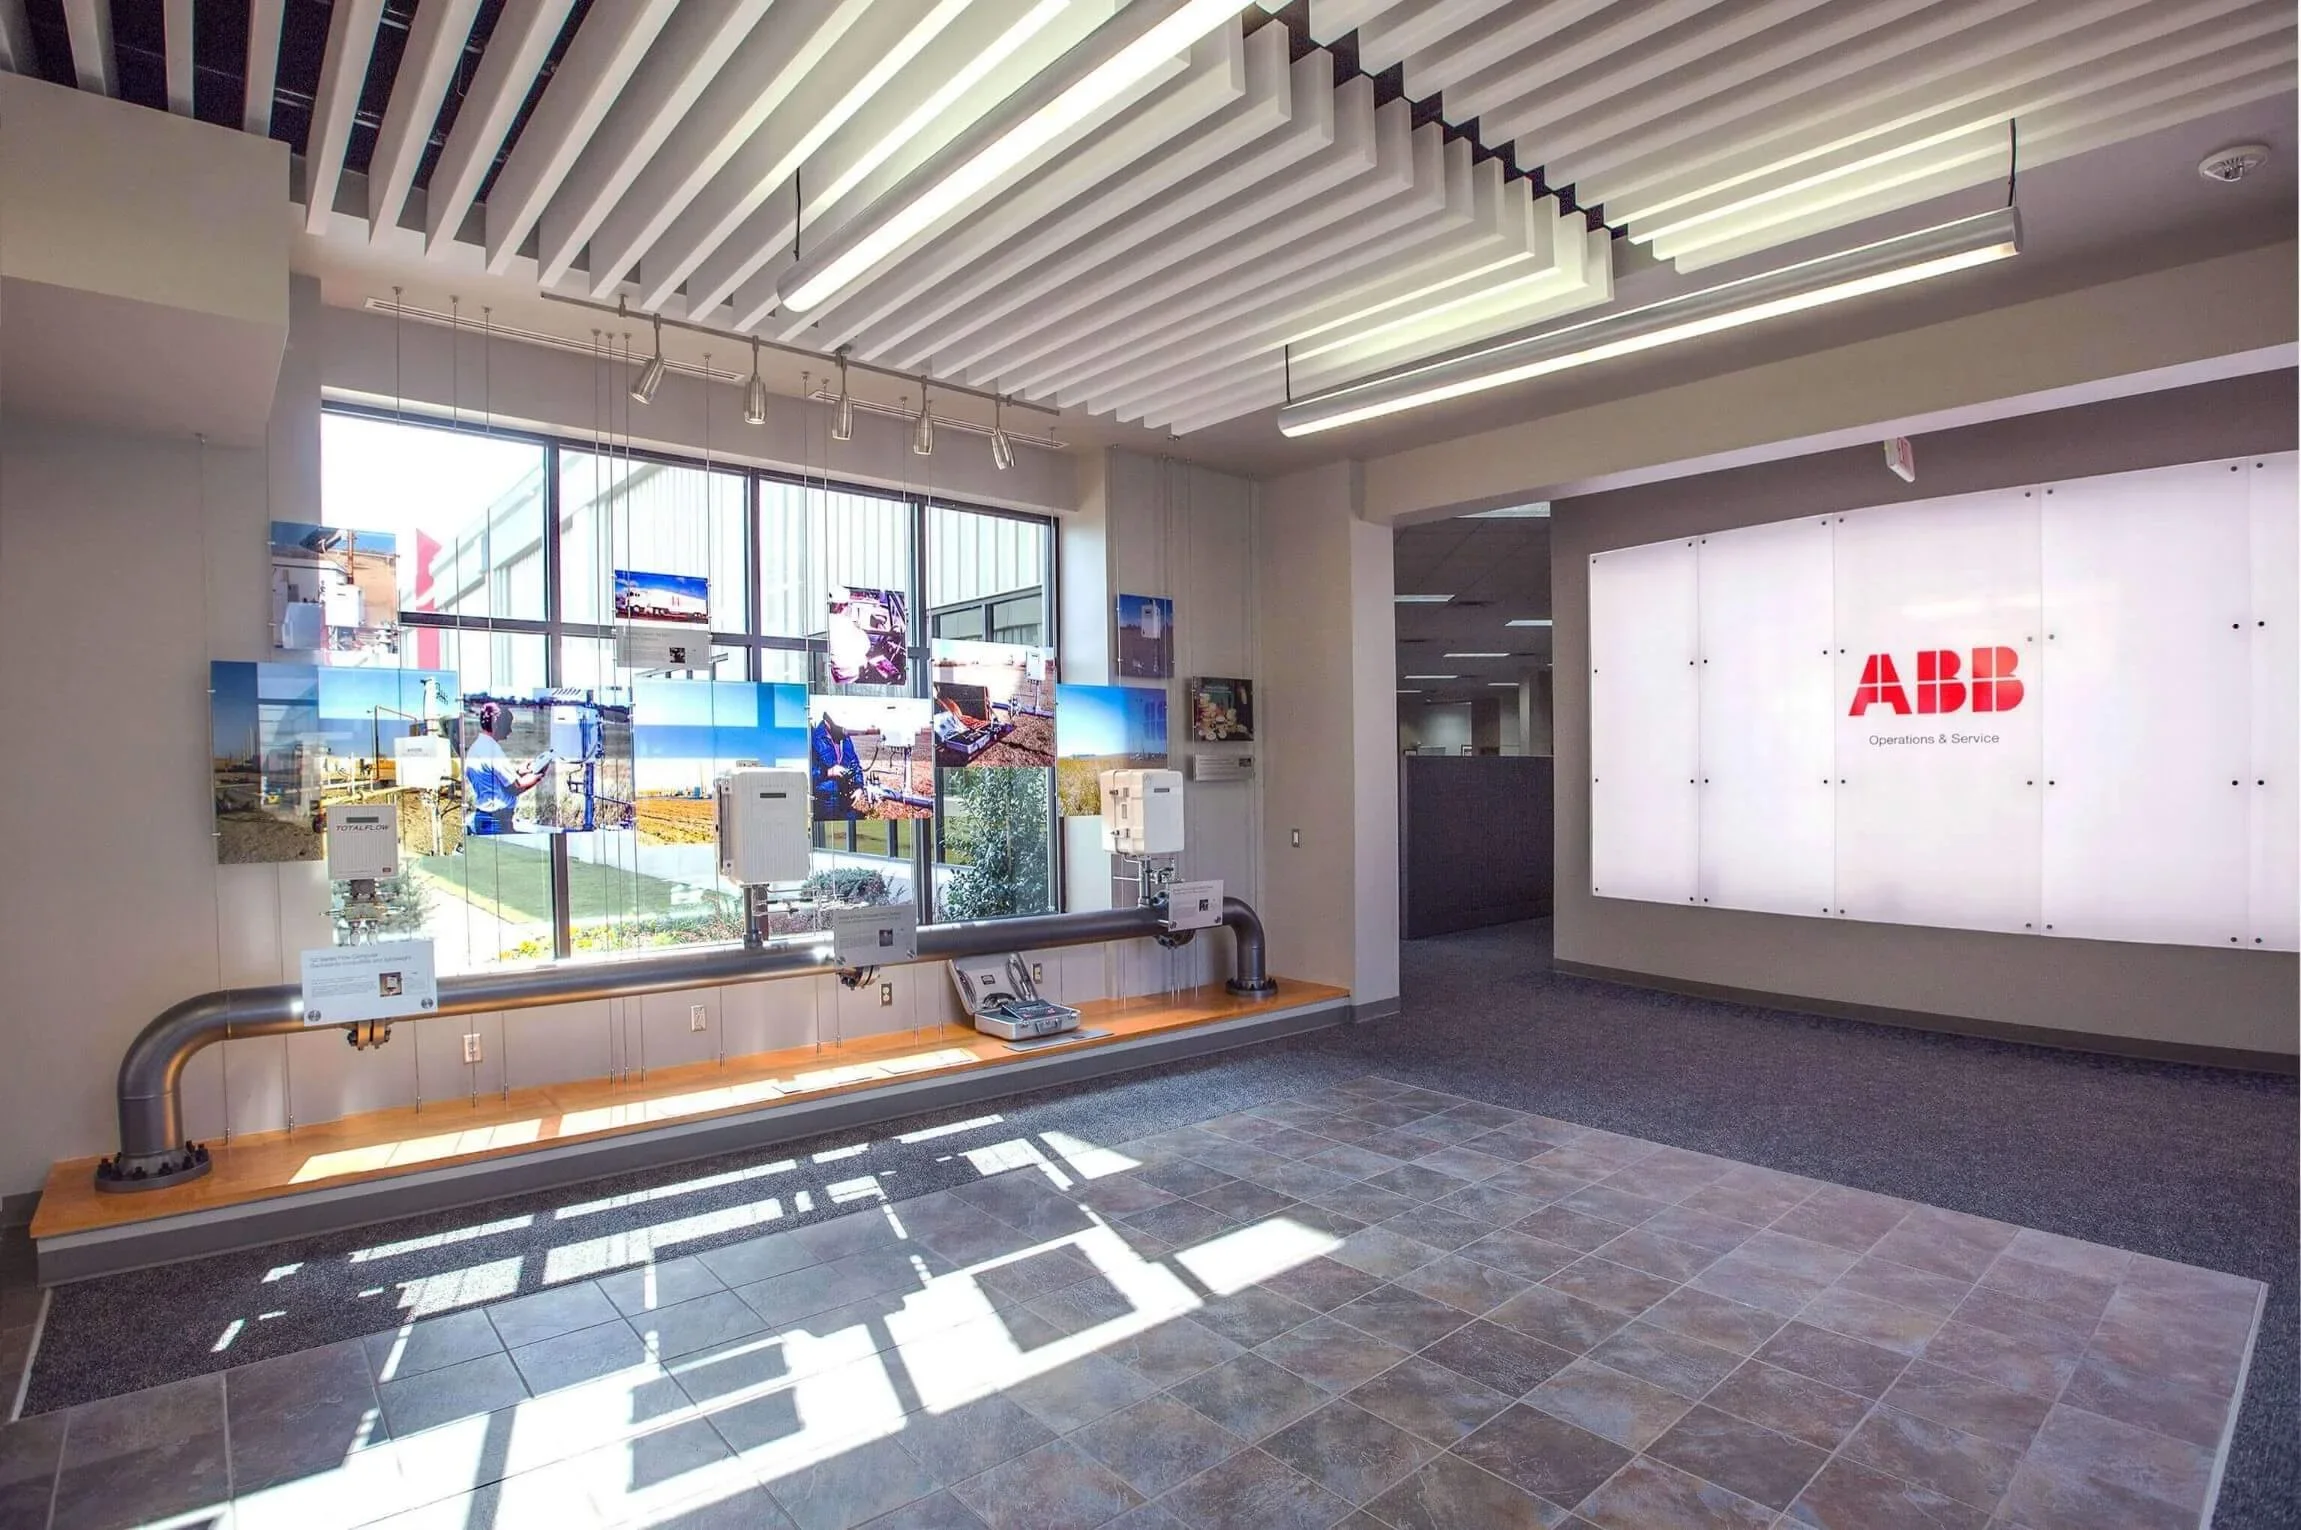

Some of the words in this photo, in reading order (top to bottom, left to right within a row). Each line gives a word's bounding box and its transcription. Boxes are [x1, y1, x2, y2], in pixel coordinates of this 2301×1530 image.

[1848, 646, 2025, 716] ABB
[1869, 734, 1935, 747] Operations
[1938, 734, 1947, 744] &
[1951, 733, 2000, 744] Service
